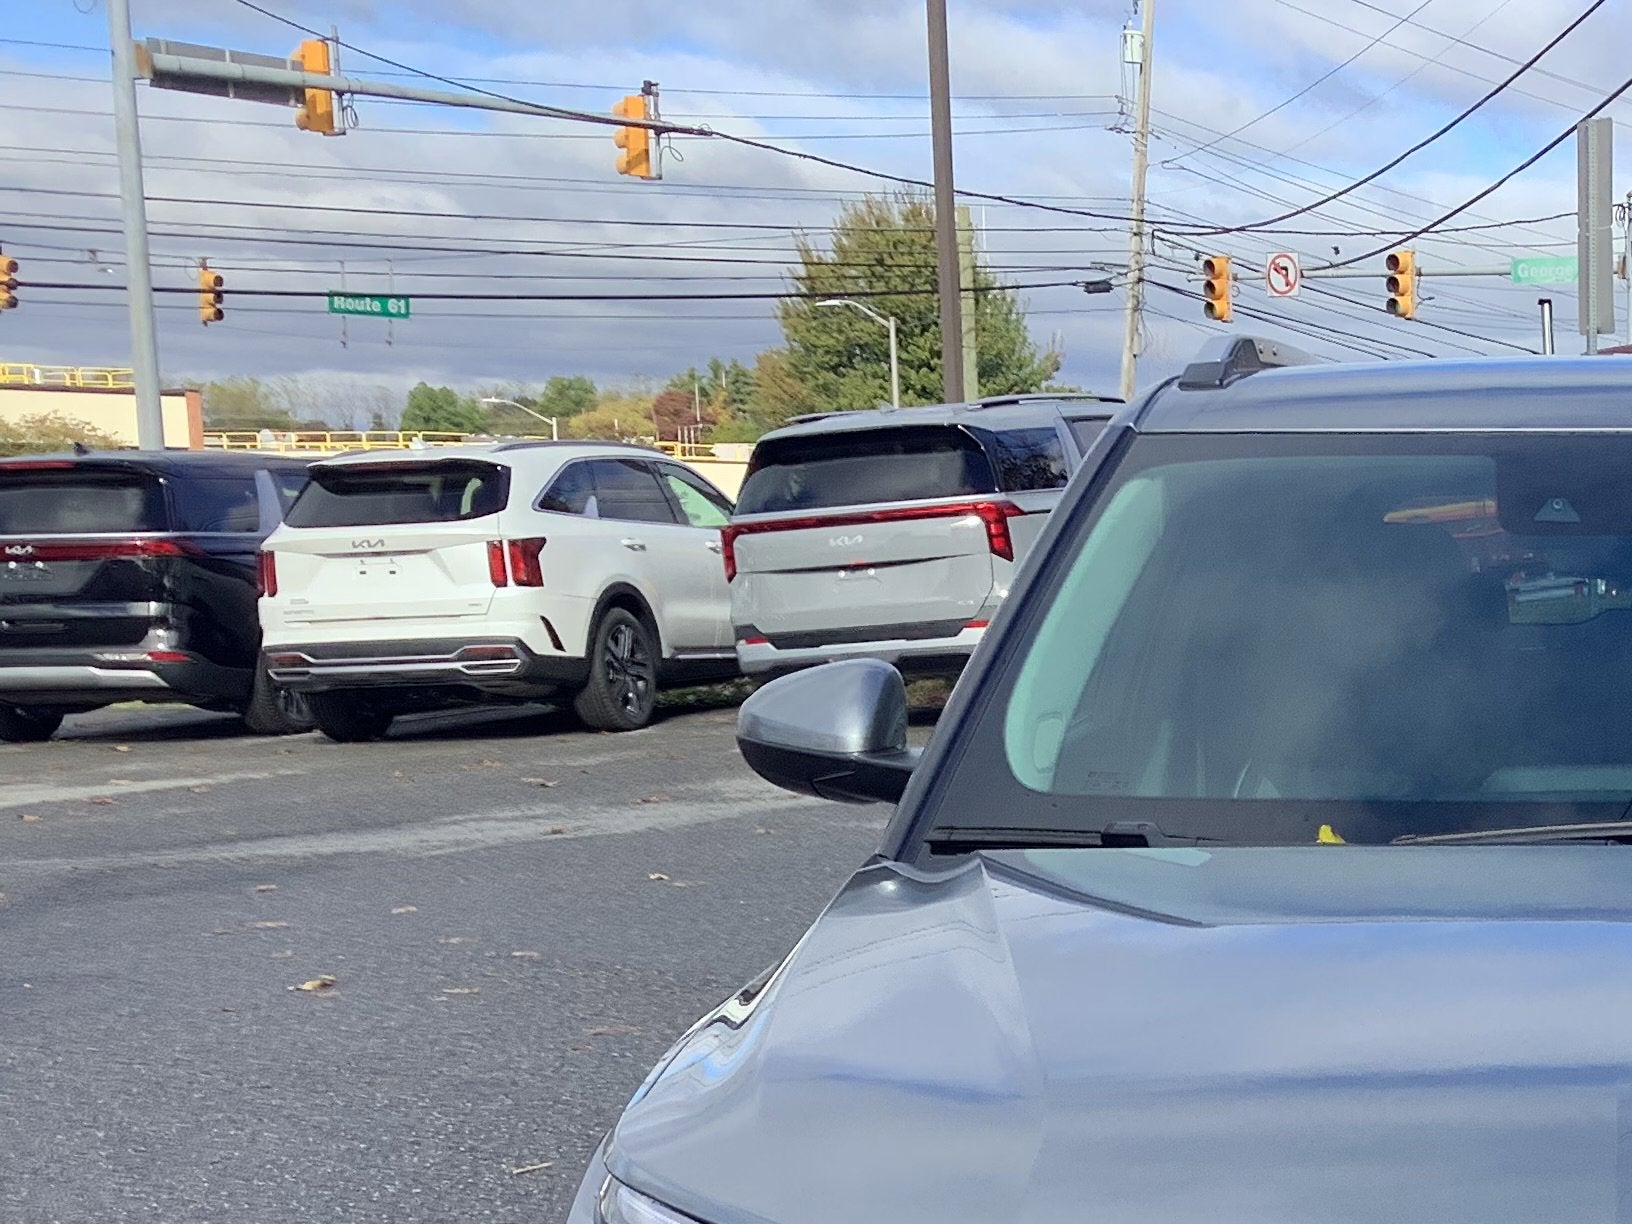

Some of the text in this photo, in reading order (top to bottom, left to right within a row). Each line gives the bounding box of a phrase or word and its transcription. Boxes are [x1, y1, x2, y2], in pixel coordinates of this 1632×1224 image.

[1518, 263, 1576, 281] George
[334, 296, 405, 314] Route 61
